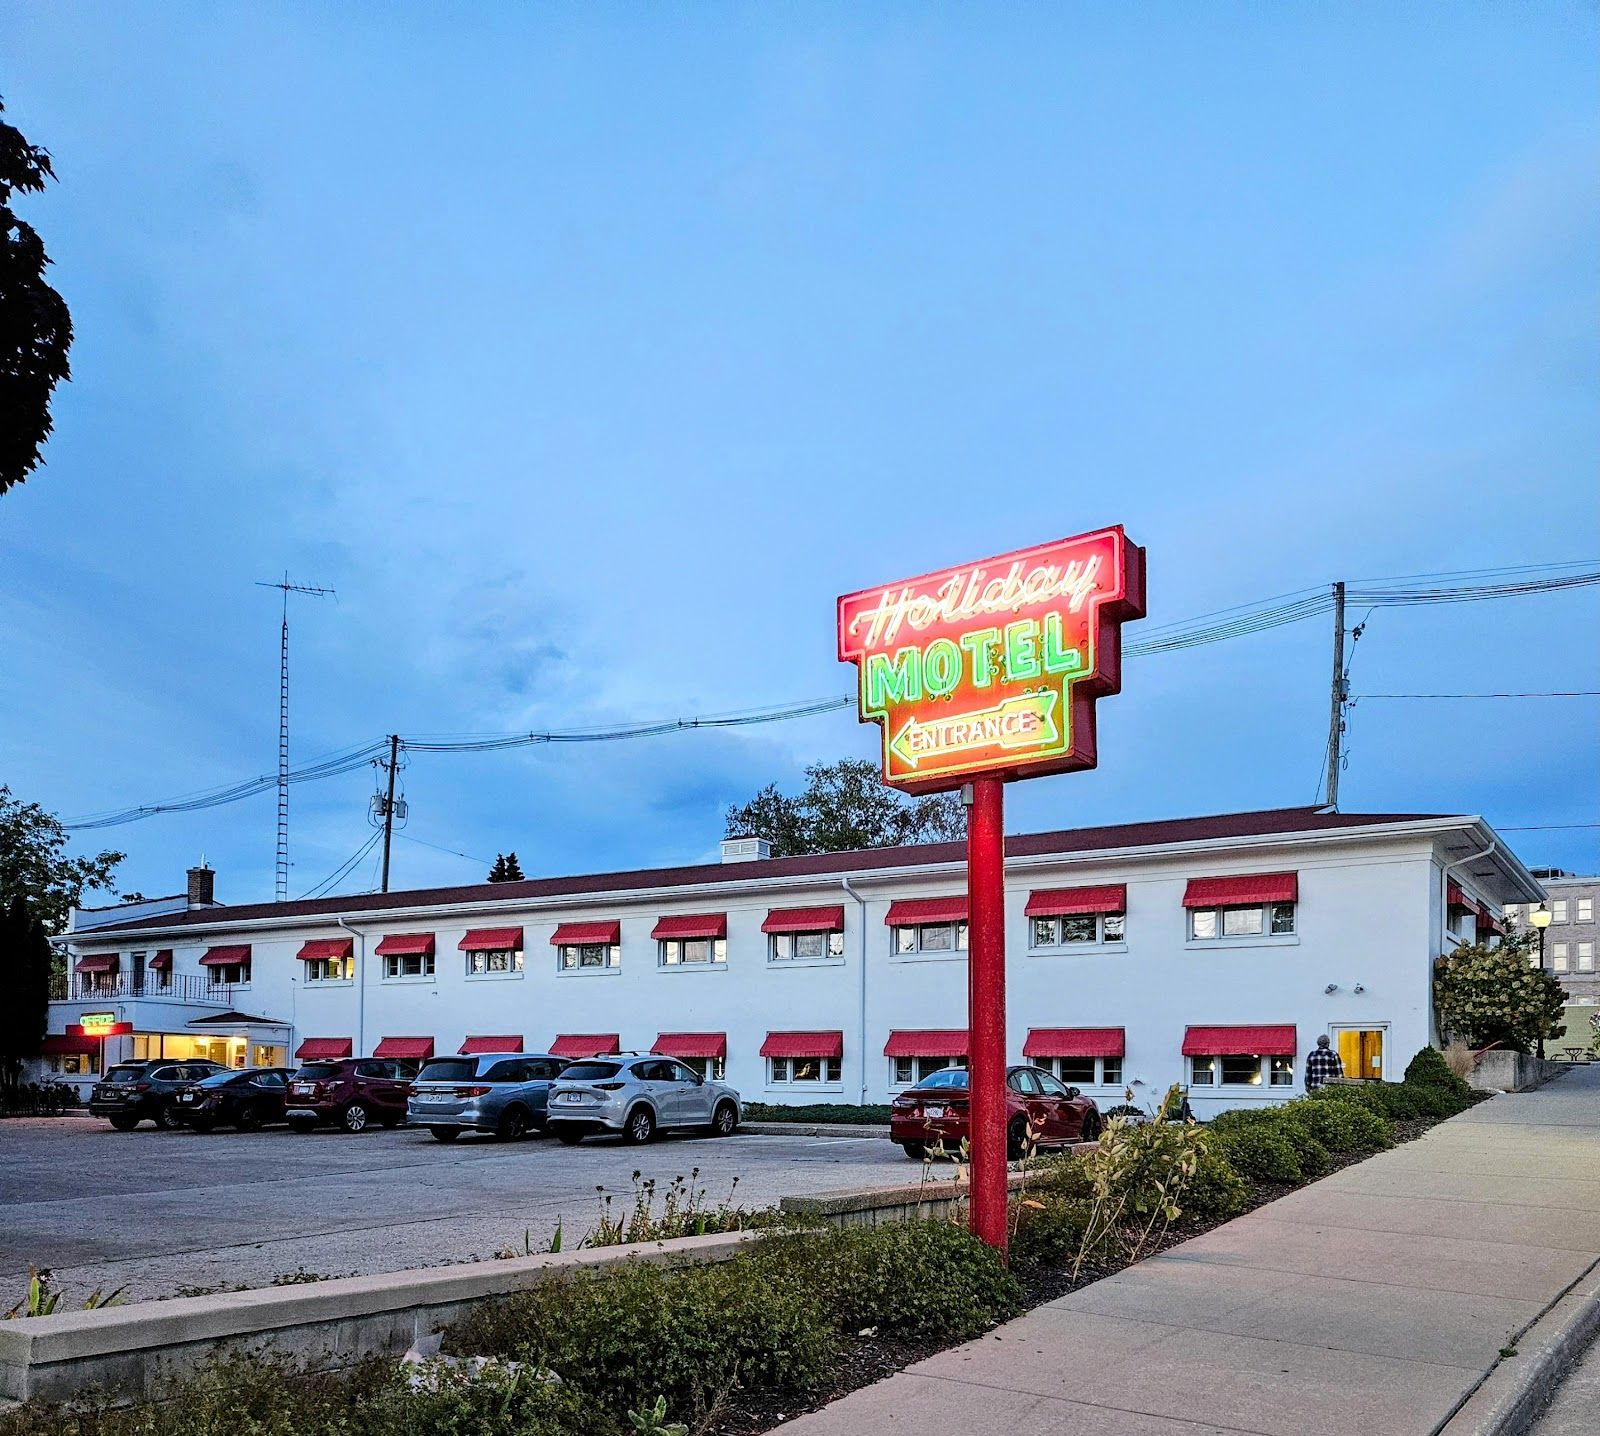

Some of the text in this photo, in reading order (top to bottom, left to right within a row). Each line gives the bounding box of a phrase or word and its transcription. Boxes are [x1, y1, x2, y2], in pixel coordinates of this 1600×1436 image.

[849, 555, 1103, 648] Holiday
[867, 611, 1081, 707] MOTEL
[909, 709, 1035, 751] ENTRANCE
